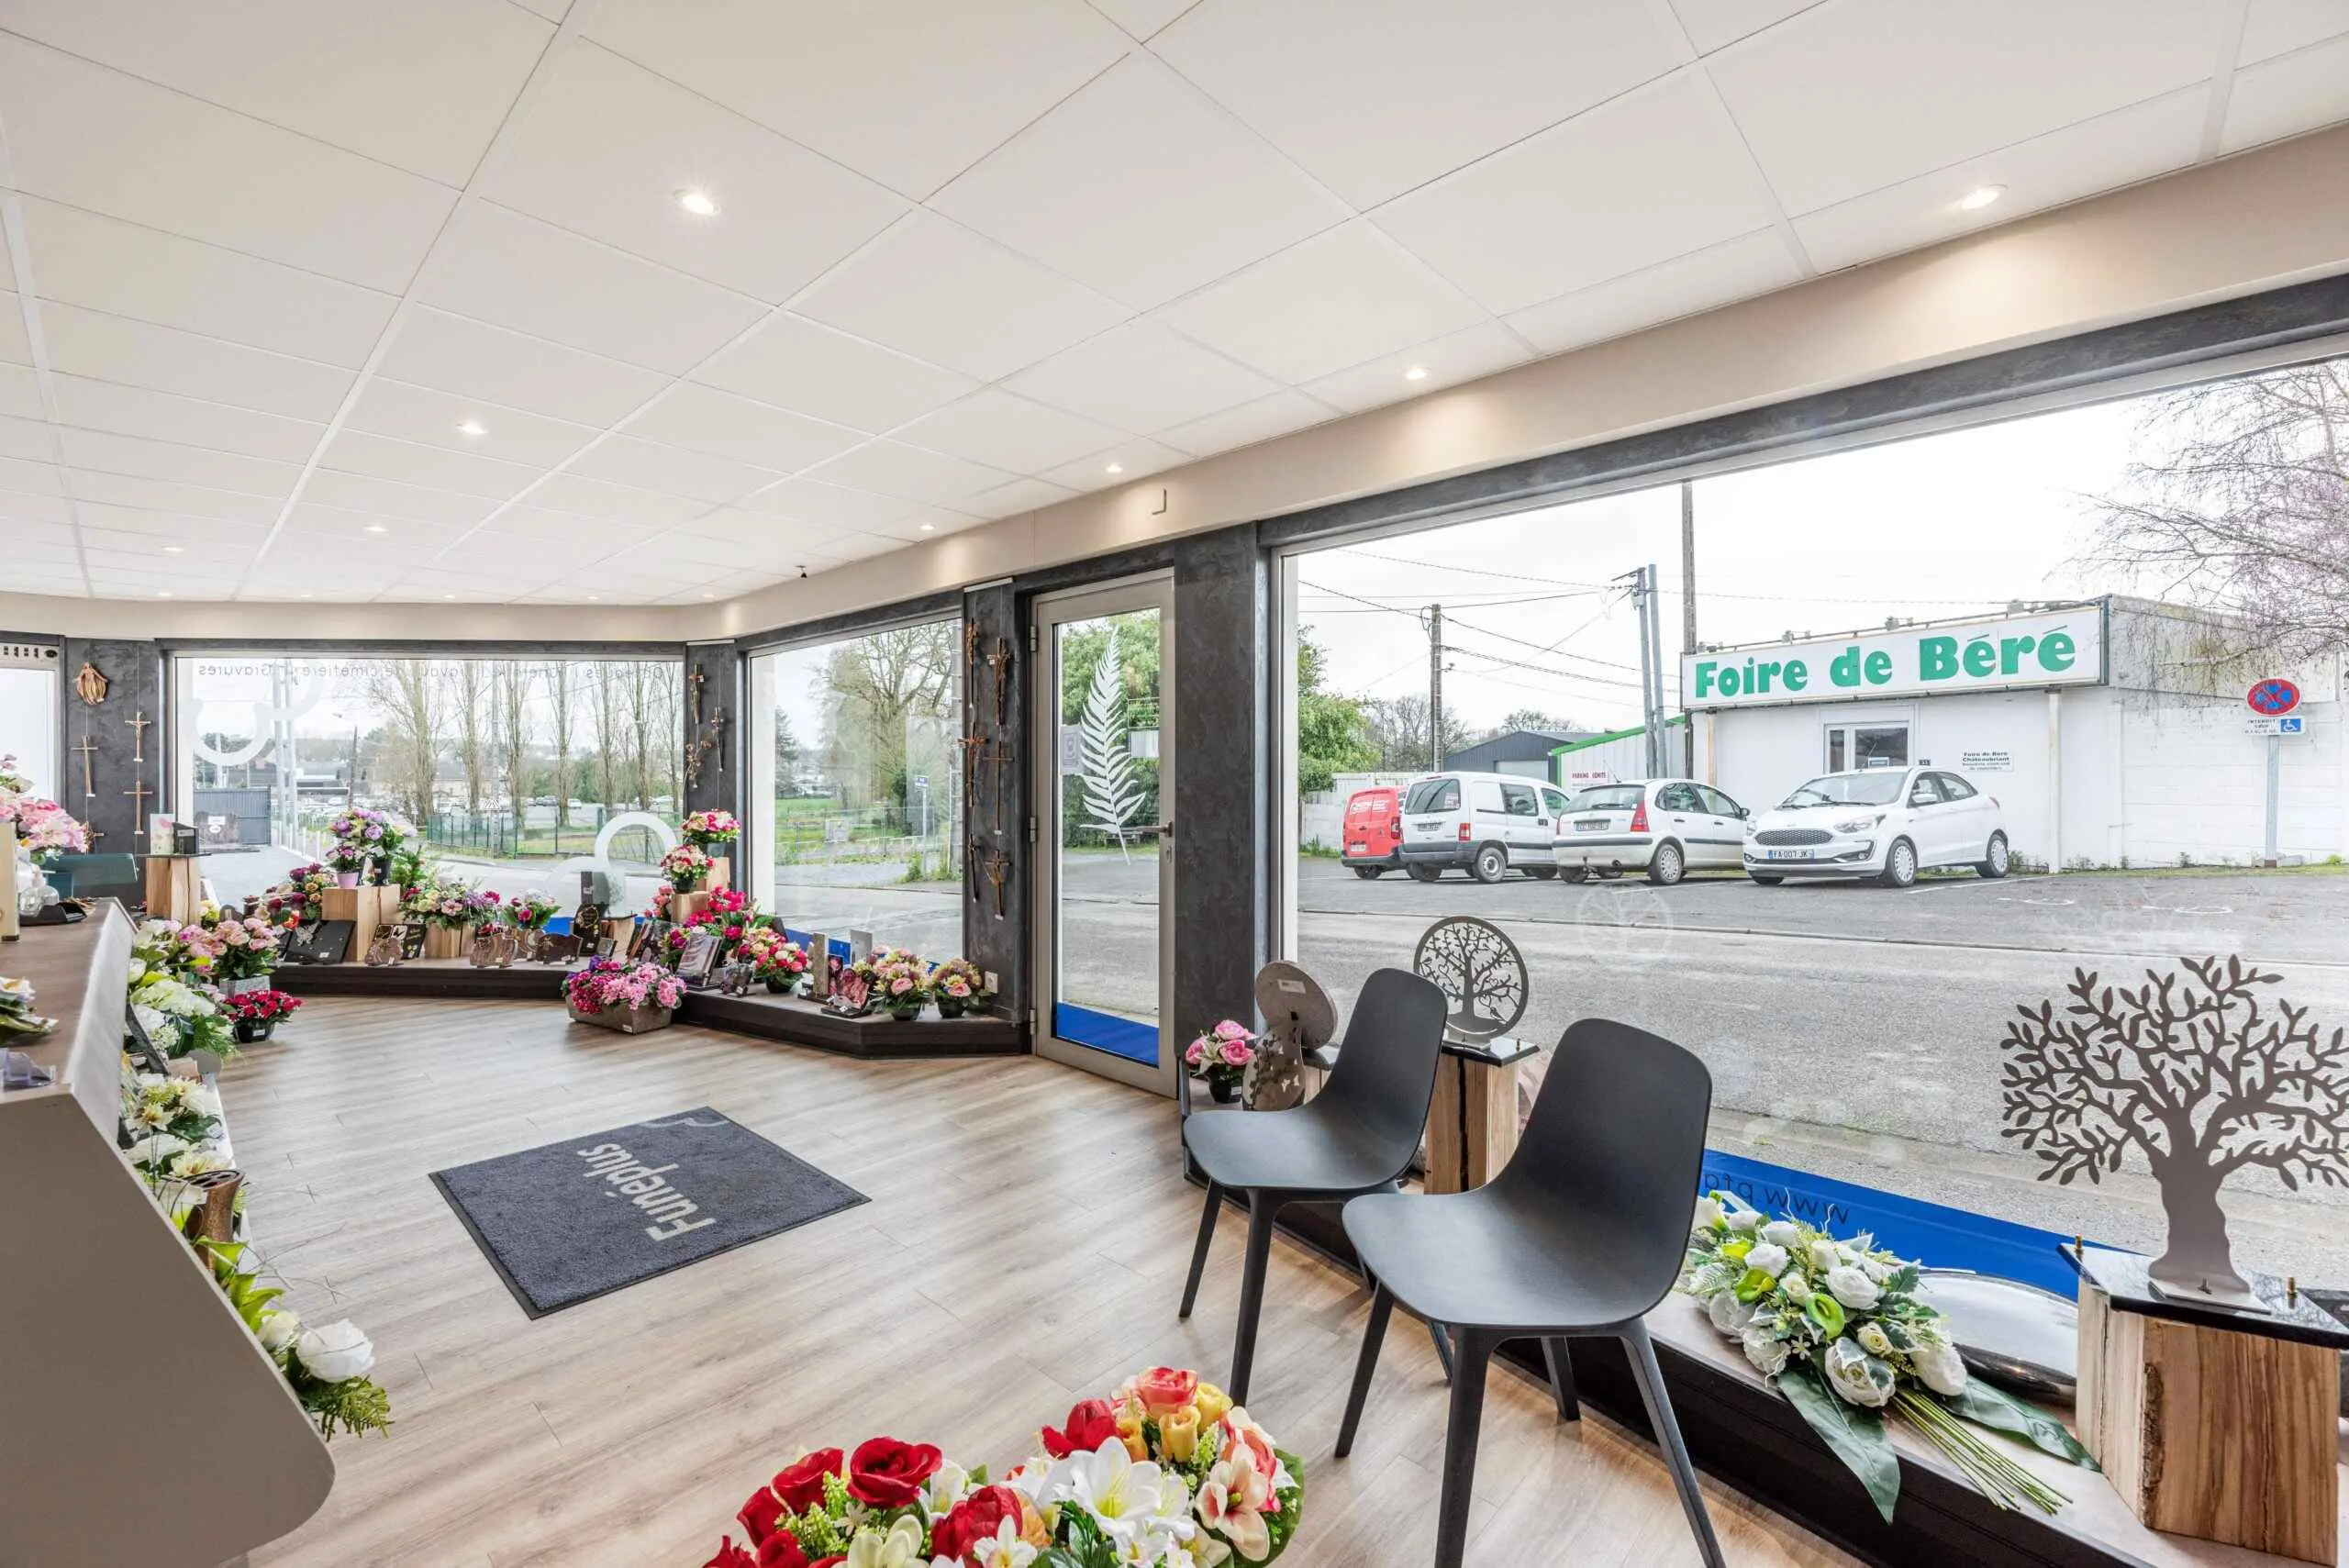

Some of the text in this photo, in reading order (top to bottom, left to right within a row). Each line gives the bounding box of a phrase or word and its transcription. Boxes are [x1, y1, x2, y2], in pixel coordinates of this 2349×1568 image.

[1695, 625, 2076, 698] Foire de Béré
[576, 1142, 718, 1242] Funéplus
